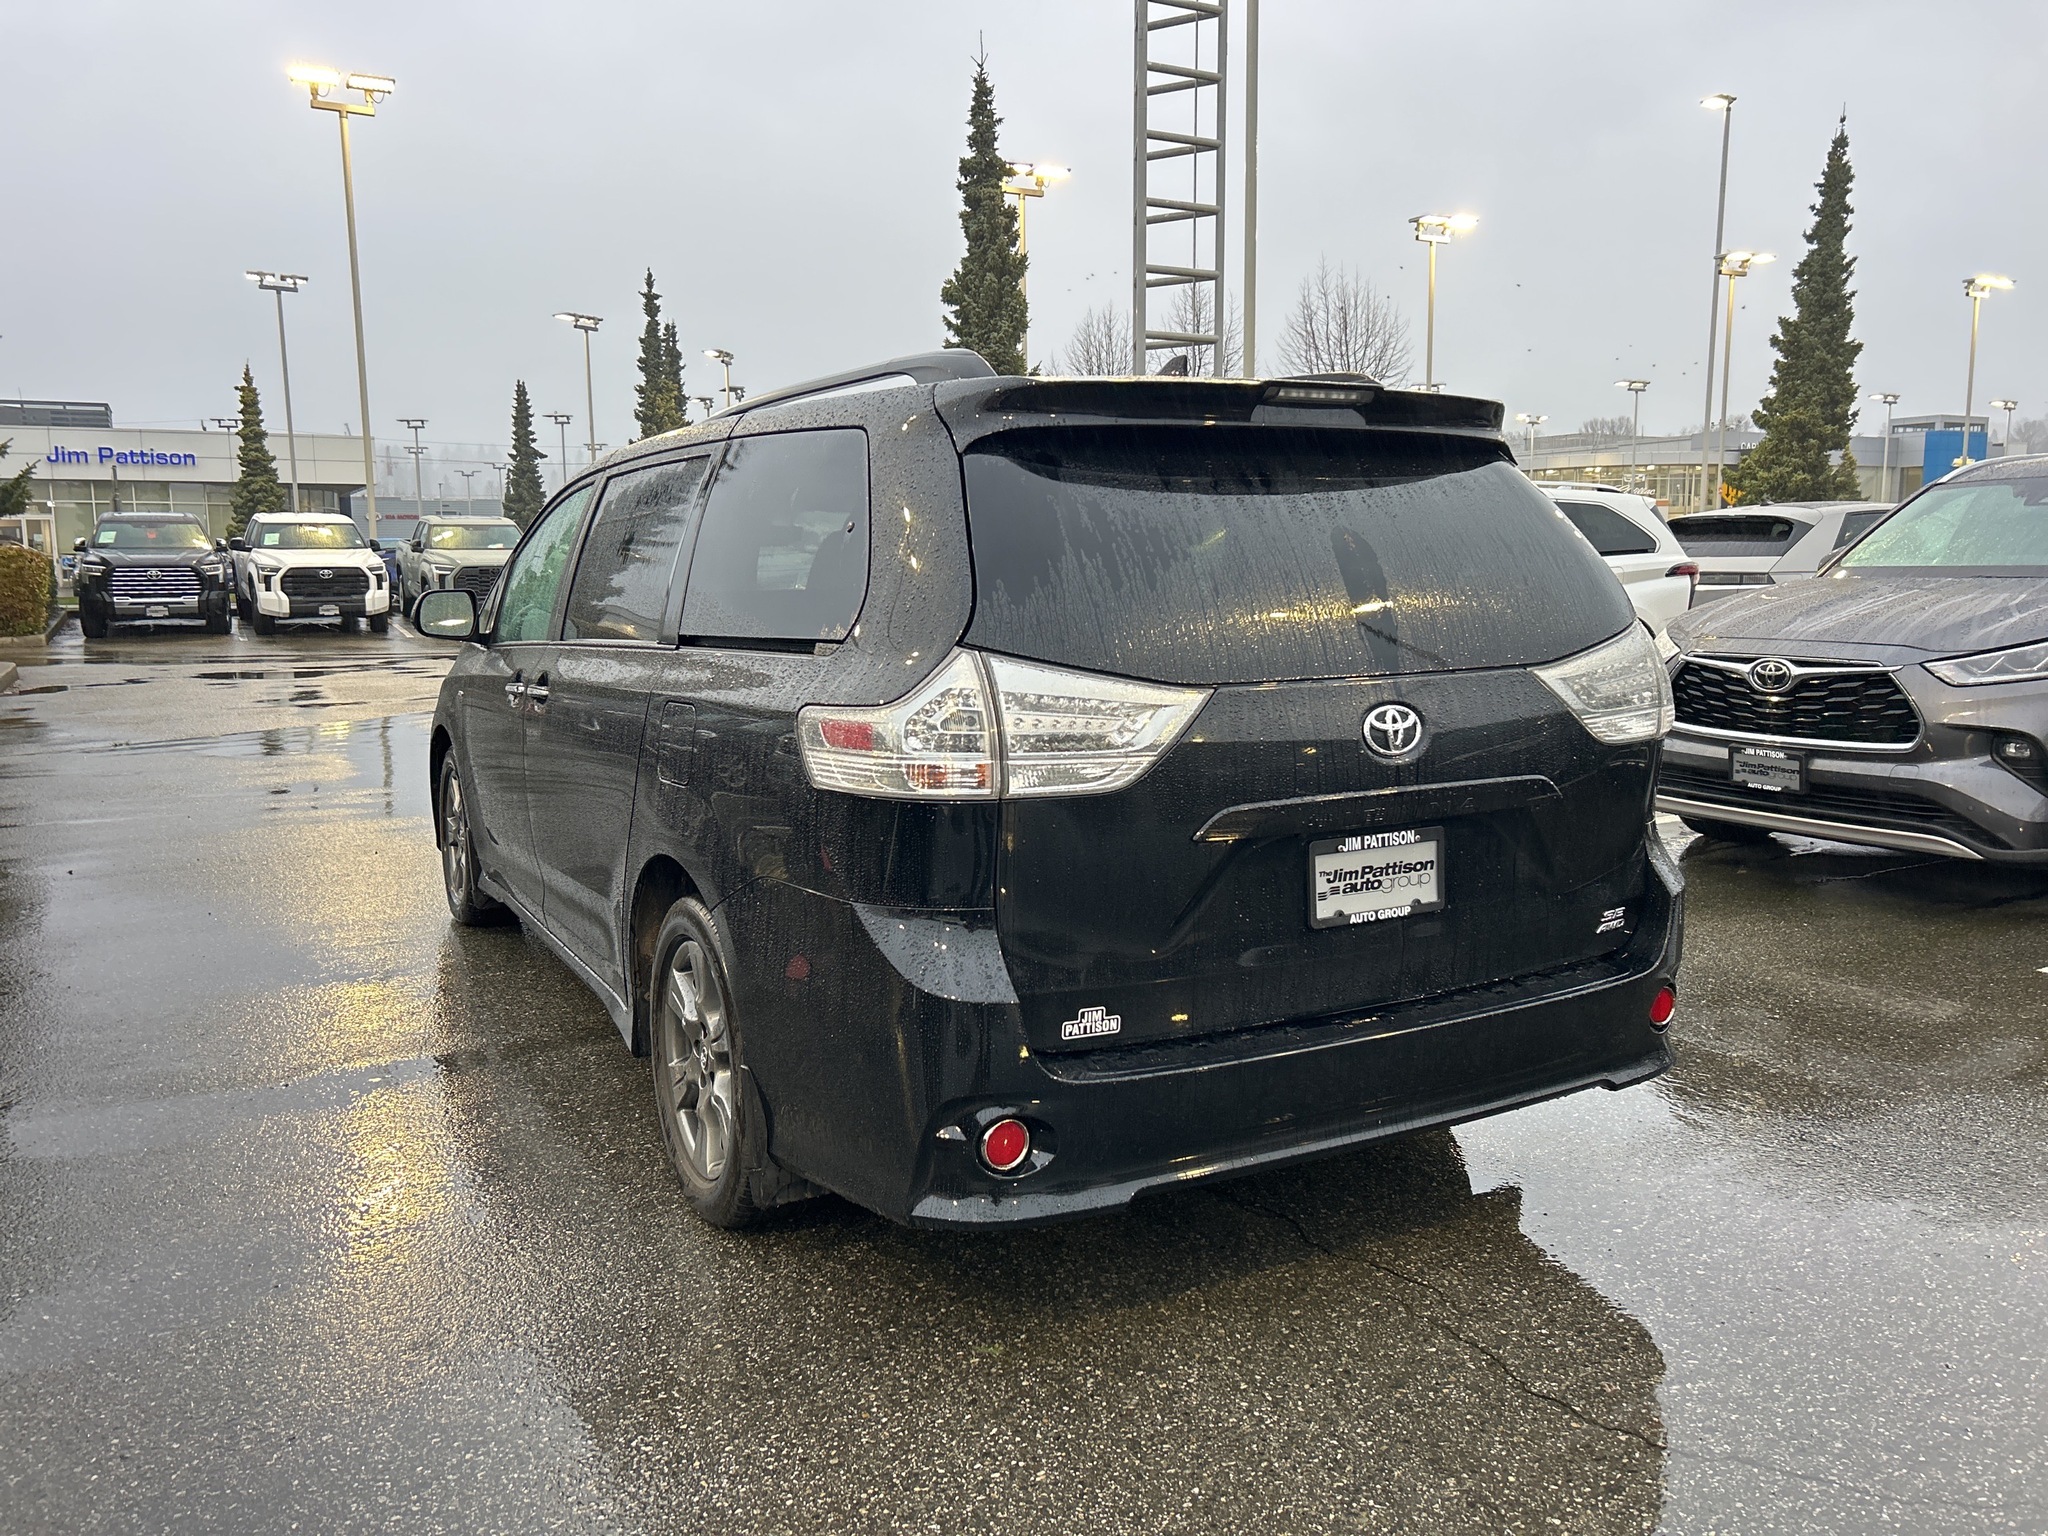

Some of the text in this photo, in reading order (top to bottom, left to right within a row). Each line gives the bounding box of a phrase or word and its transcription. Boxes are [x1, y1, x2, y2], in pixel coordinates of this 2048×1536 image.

[46, 445, 196, 466] Jim Pattison
[1743, 748, 1785, 759] JIM PATTISON
[1762, 784, 1782, 792] GROUP
[1343, 830, 1415, 852] JIM PATTISON
[1349, 905, 1412, 924] AUTO GROUP
[1081, 1009, 1103, 1023] JIM
[1065, 1018, 1118, 1037] PATTISON
